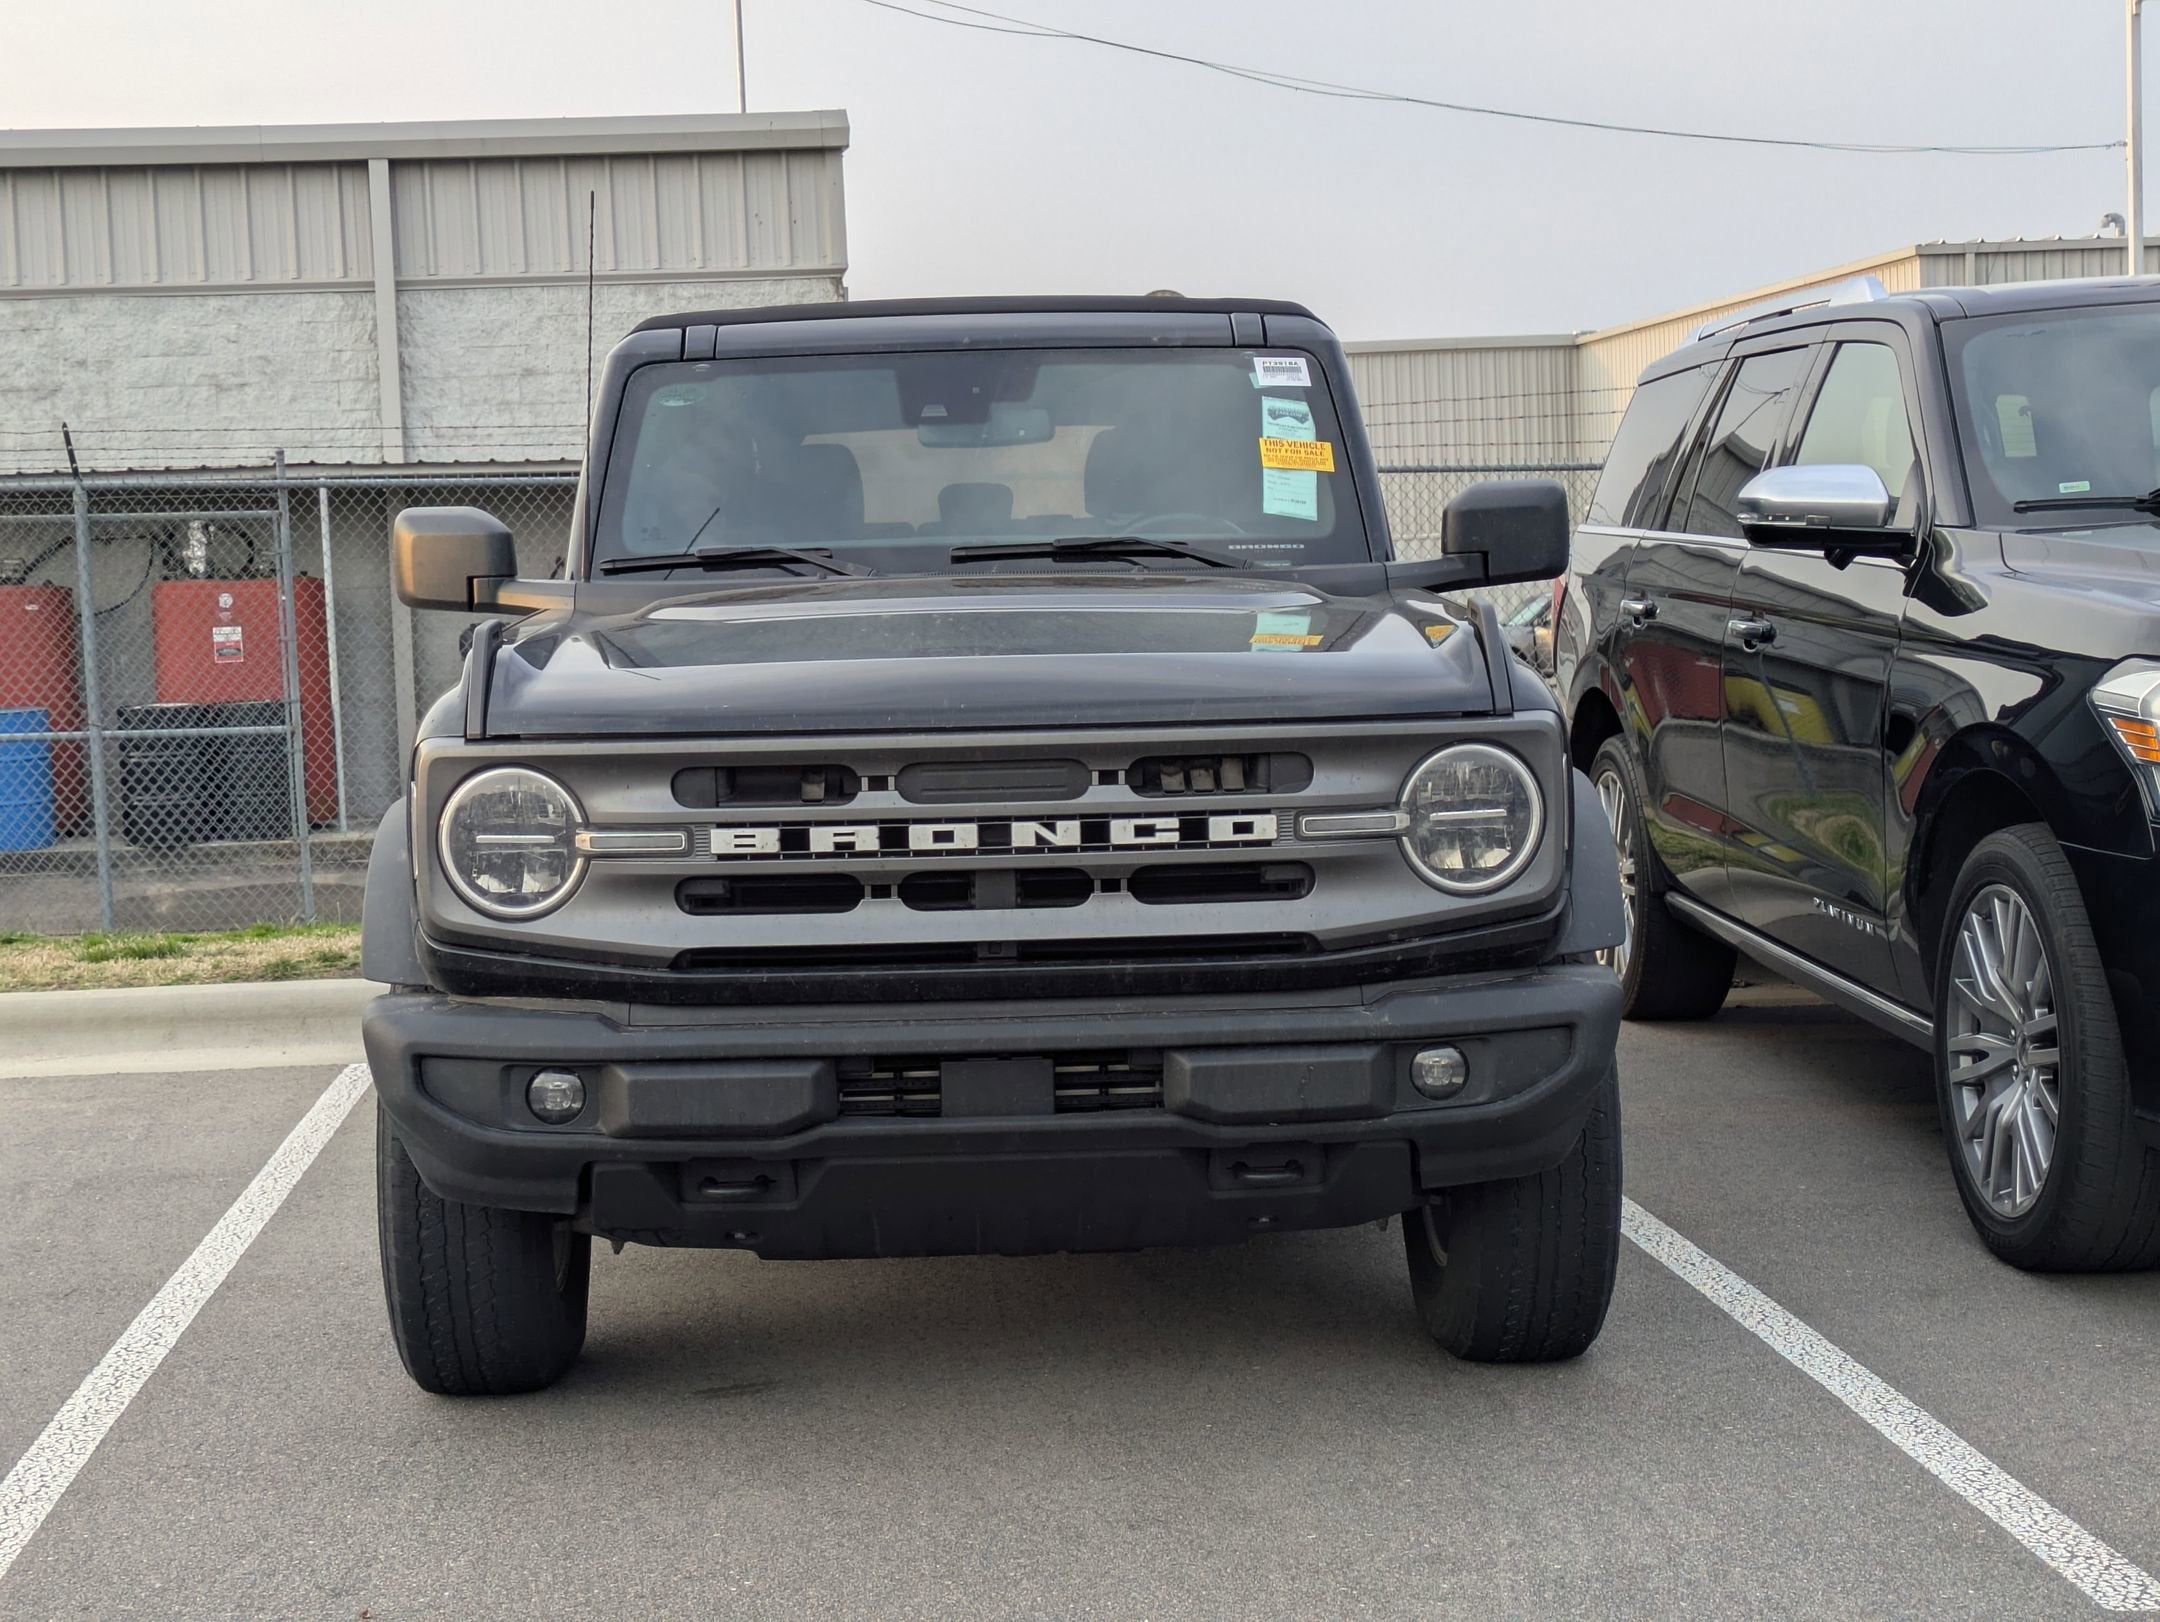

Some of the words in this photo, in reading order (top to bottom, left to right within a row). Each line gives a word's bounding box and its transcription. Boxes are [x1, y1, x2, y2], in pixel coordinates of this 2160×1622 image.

[1263, 439, 1285, 447] THIS
[1286, 440, 1326, 451] VEHICLE
[1285, 447, 1302, 455] FOR
[1304, 449, 1325, 457] SALE
[710, 814, 1278, 854] BRONCO
[1812, 896, 1875, 937] PLATINUM
